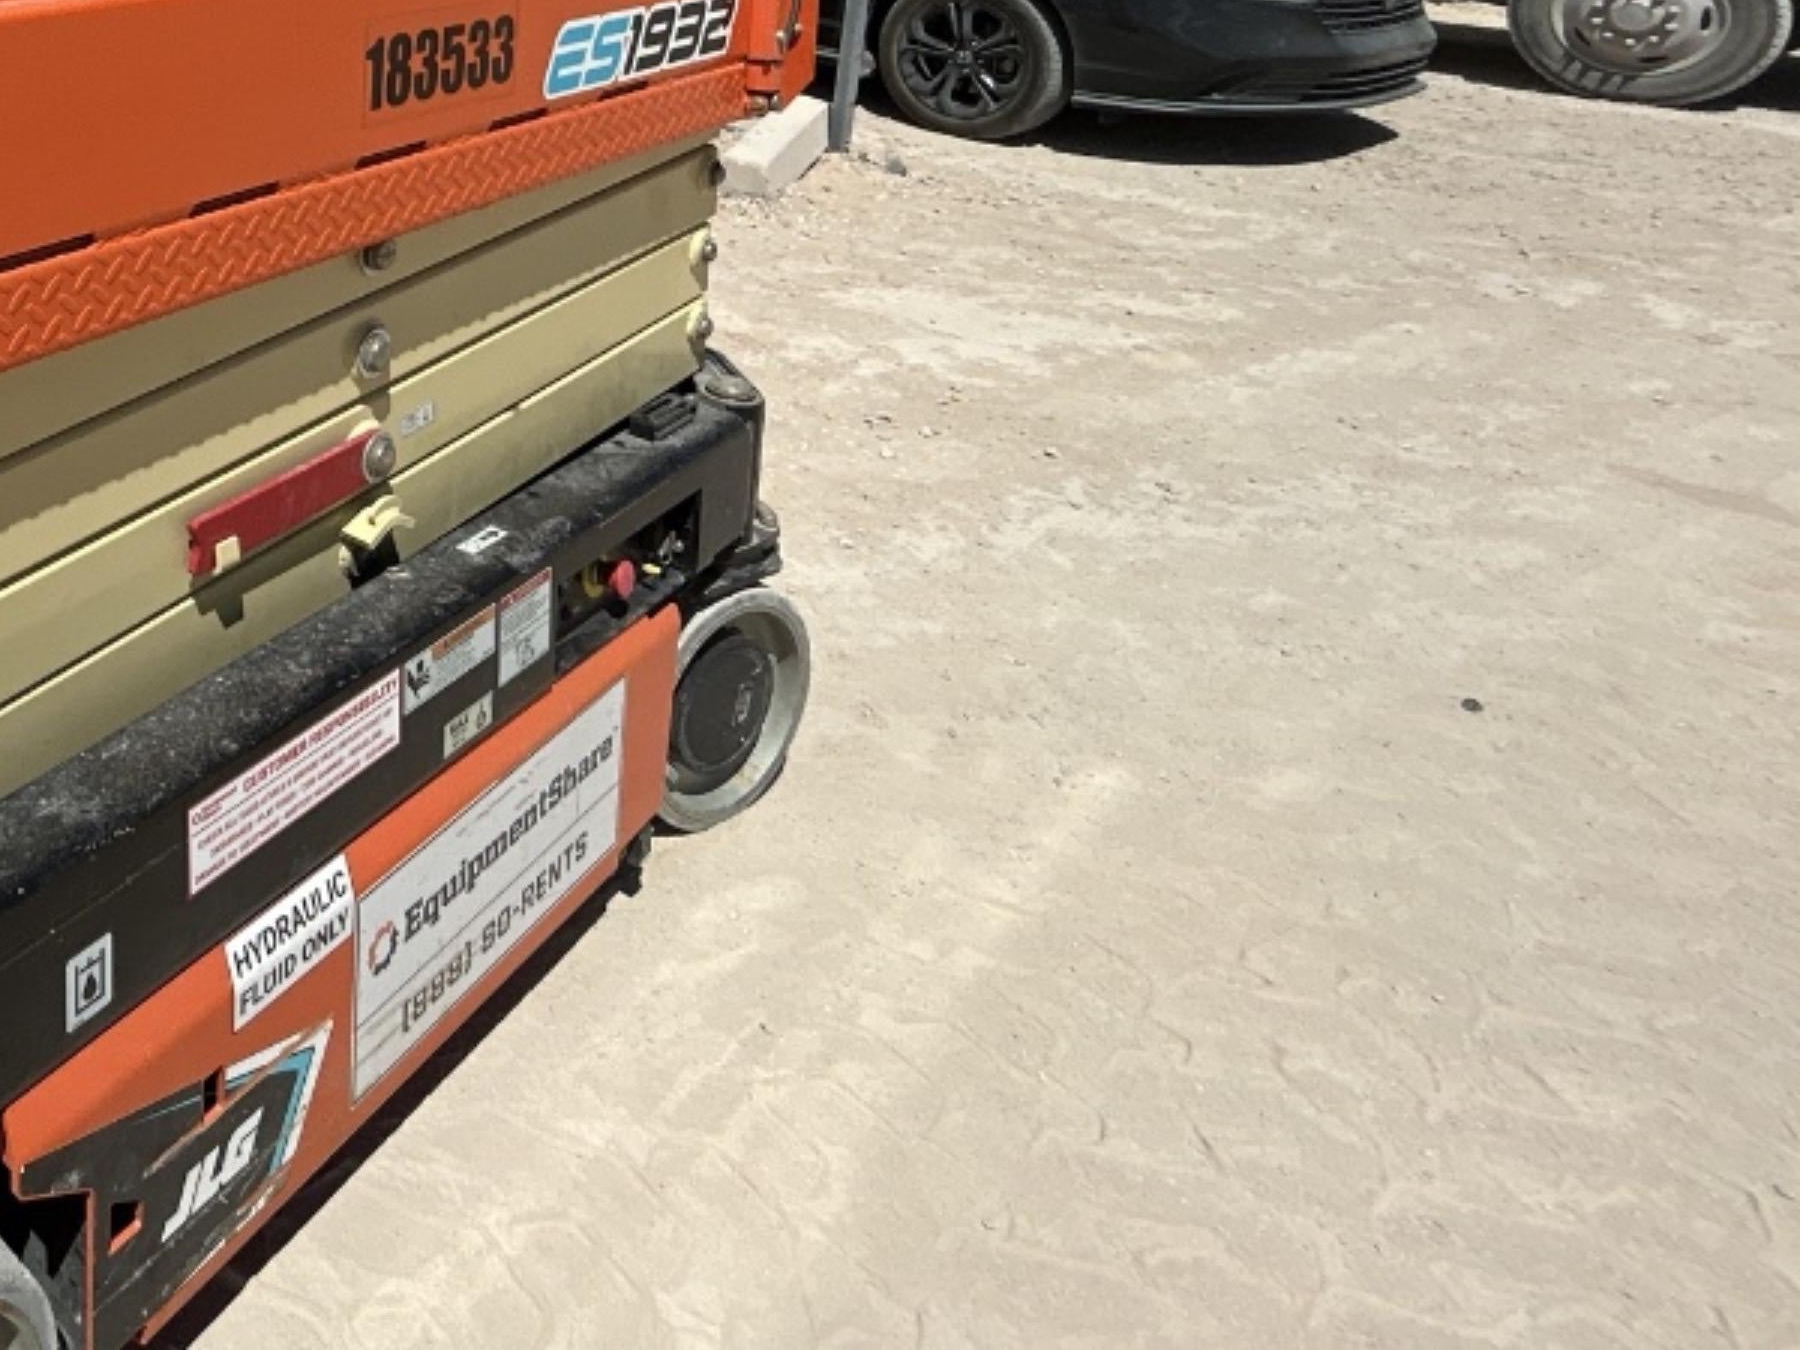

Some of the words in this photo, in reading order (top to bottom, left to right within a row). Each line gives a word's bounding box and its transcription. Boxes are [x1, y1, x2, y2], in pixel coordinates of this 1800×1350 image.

[365, 14, 514, 111] 183533
[404, 734, 613, 942] EquipmentShare
[233, 869, 347, 979] HYDRAULIC
[239, 952, 298, 1016] FLUID
[302, 906, 349, 963] ONLY
[160, 1105, 265, 1243] JLG
